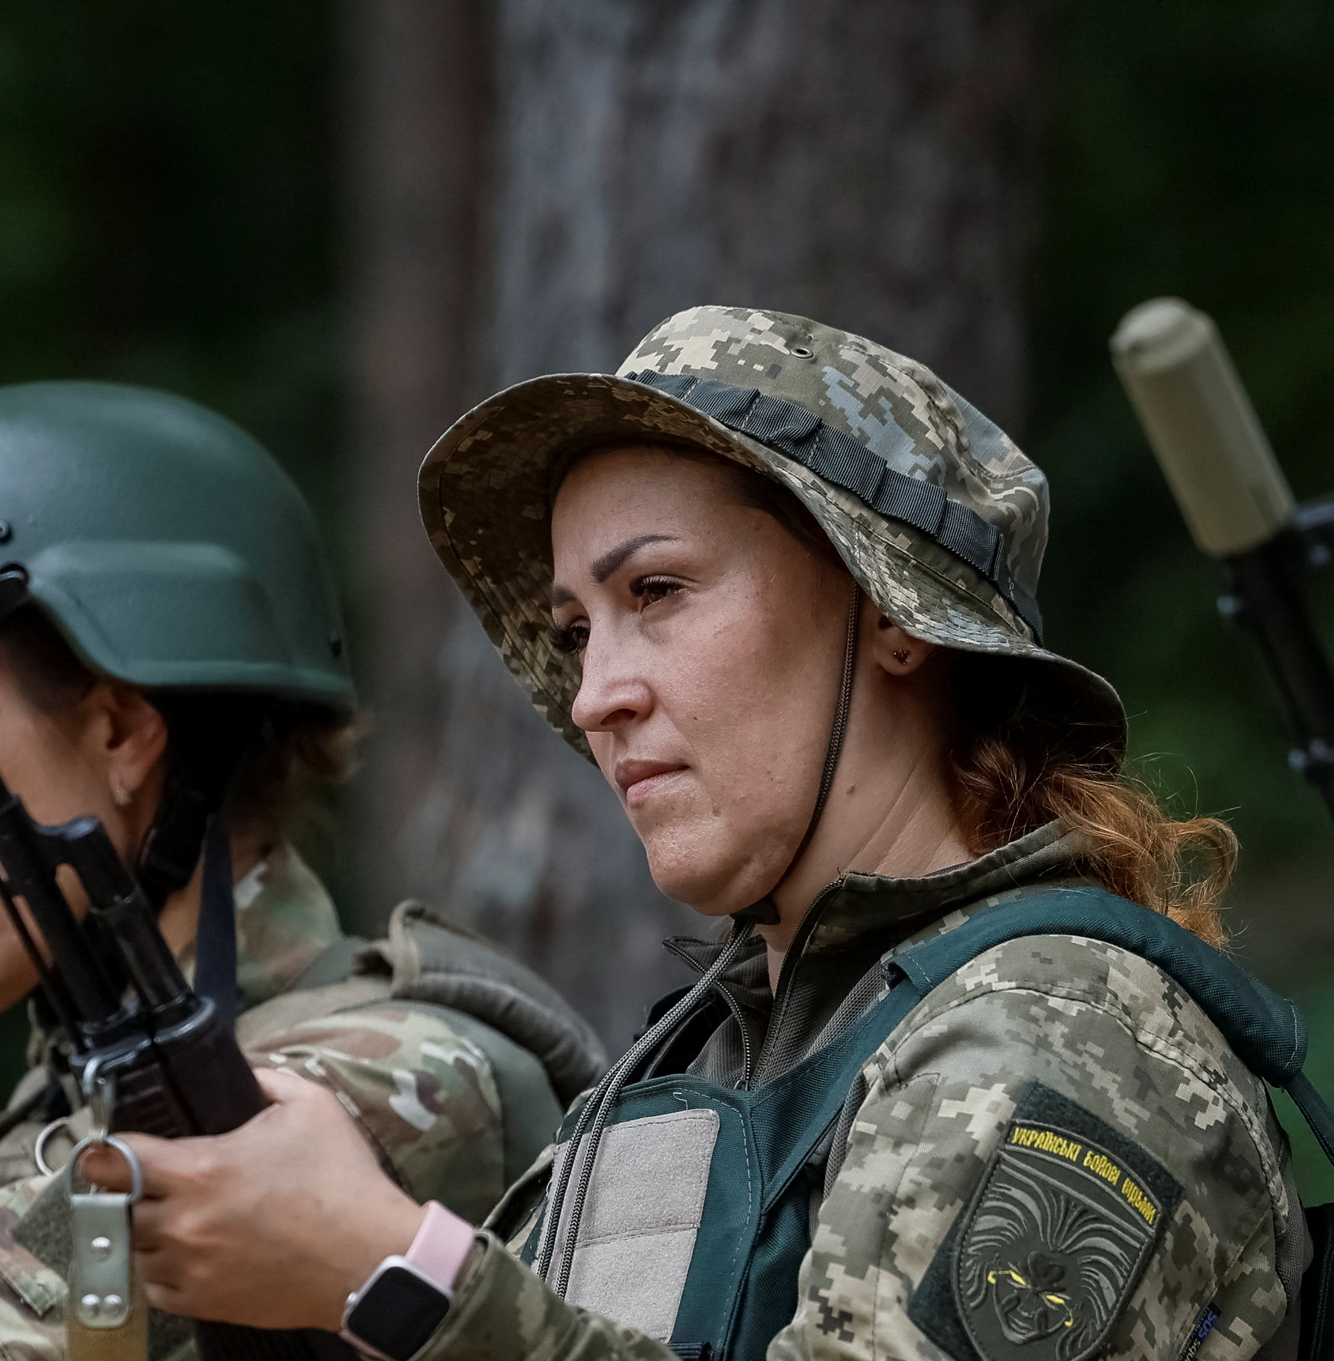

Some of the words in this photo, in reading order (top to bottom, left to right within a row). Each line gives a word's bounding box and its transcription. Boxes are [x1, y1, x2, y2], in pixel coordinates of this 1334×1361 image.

[1011, 1127, 1083, 1162] УКРАЇНСЬКІ
[1083, 1150, 1122, 1186] БОЙОВІ
[1121, 1177, 1157, 1226] ВІДЬМИ
[1198, 1310, 1218, 1339] SOS
